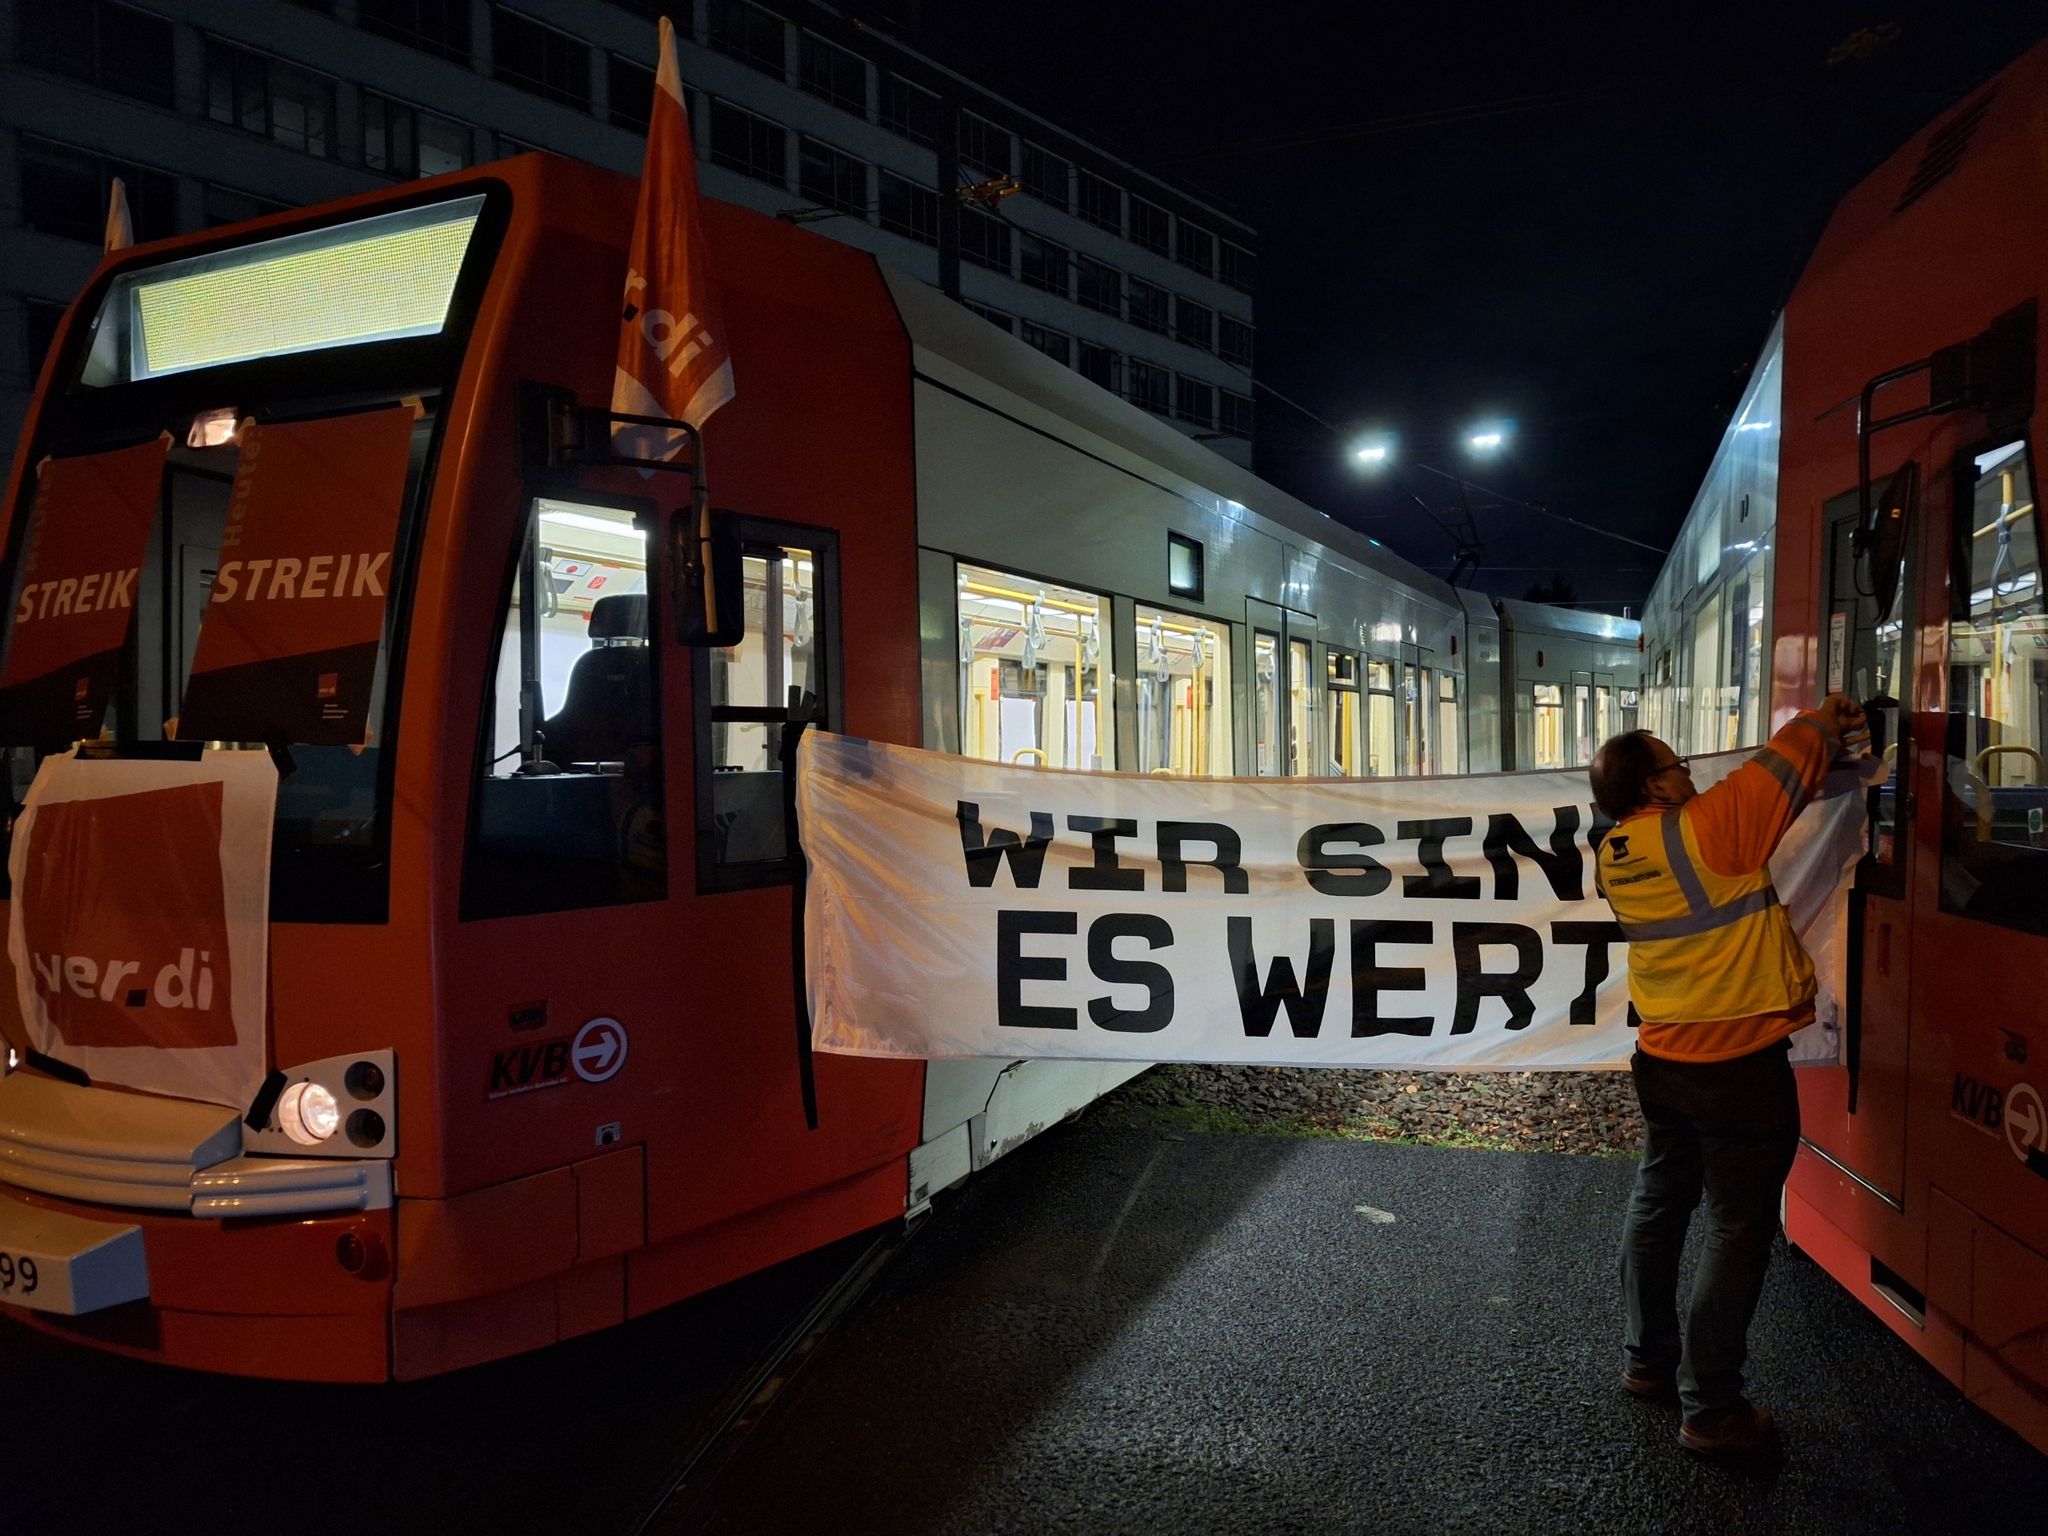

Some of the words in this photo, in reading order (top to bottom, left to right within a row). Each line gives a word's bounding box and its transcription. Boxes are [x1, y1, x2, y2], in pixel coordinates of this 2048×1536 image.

[15, 567, 139, 624] STREIK
[211, 552, 392, 603] STREIK
[956, 800, 1249, 894] WIR
[34, 947, 213, 1011] ver.di
[997, 910, 1175, 1034] ES
[489, 1040, 569, 1091] KVB
[1952, 1071, 2004, 1128] KVB
[0, 1252, 38, 1295] 99
